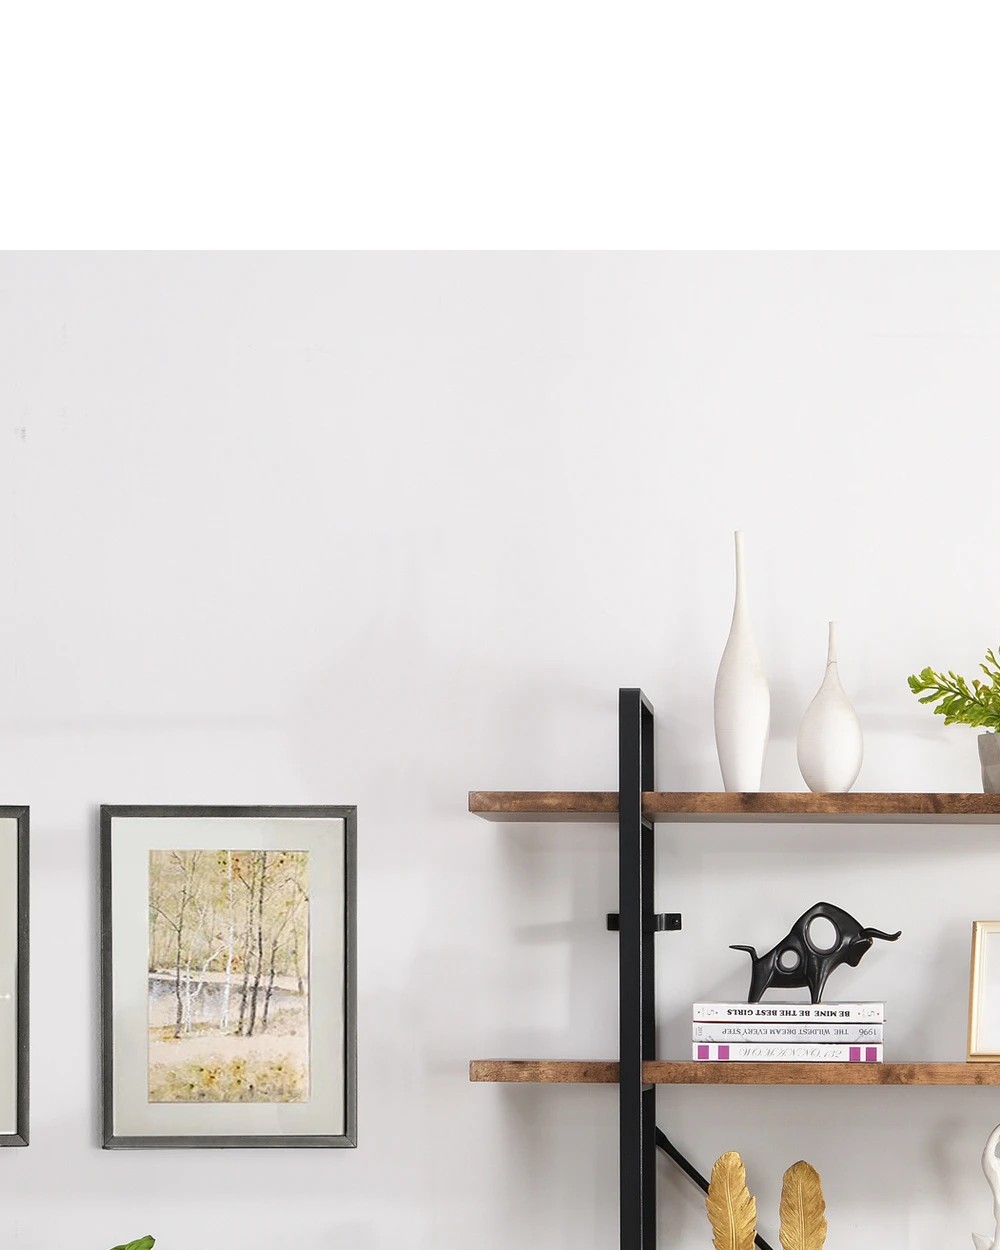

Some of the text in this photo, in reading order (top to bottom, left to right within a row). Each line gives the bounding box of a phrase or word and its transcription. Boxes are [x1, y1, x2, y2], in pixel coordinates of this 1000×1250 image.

[727, 1008, 753, 1016] GIRLS
[742, 1028, 768, 1036] EVERY
[798, 1028, 830, 1036] WILDEST
[859, 1028, 877, 1036] 1996
